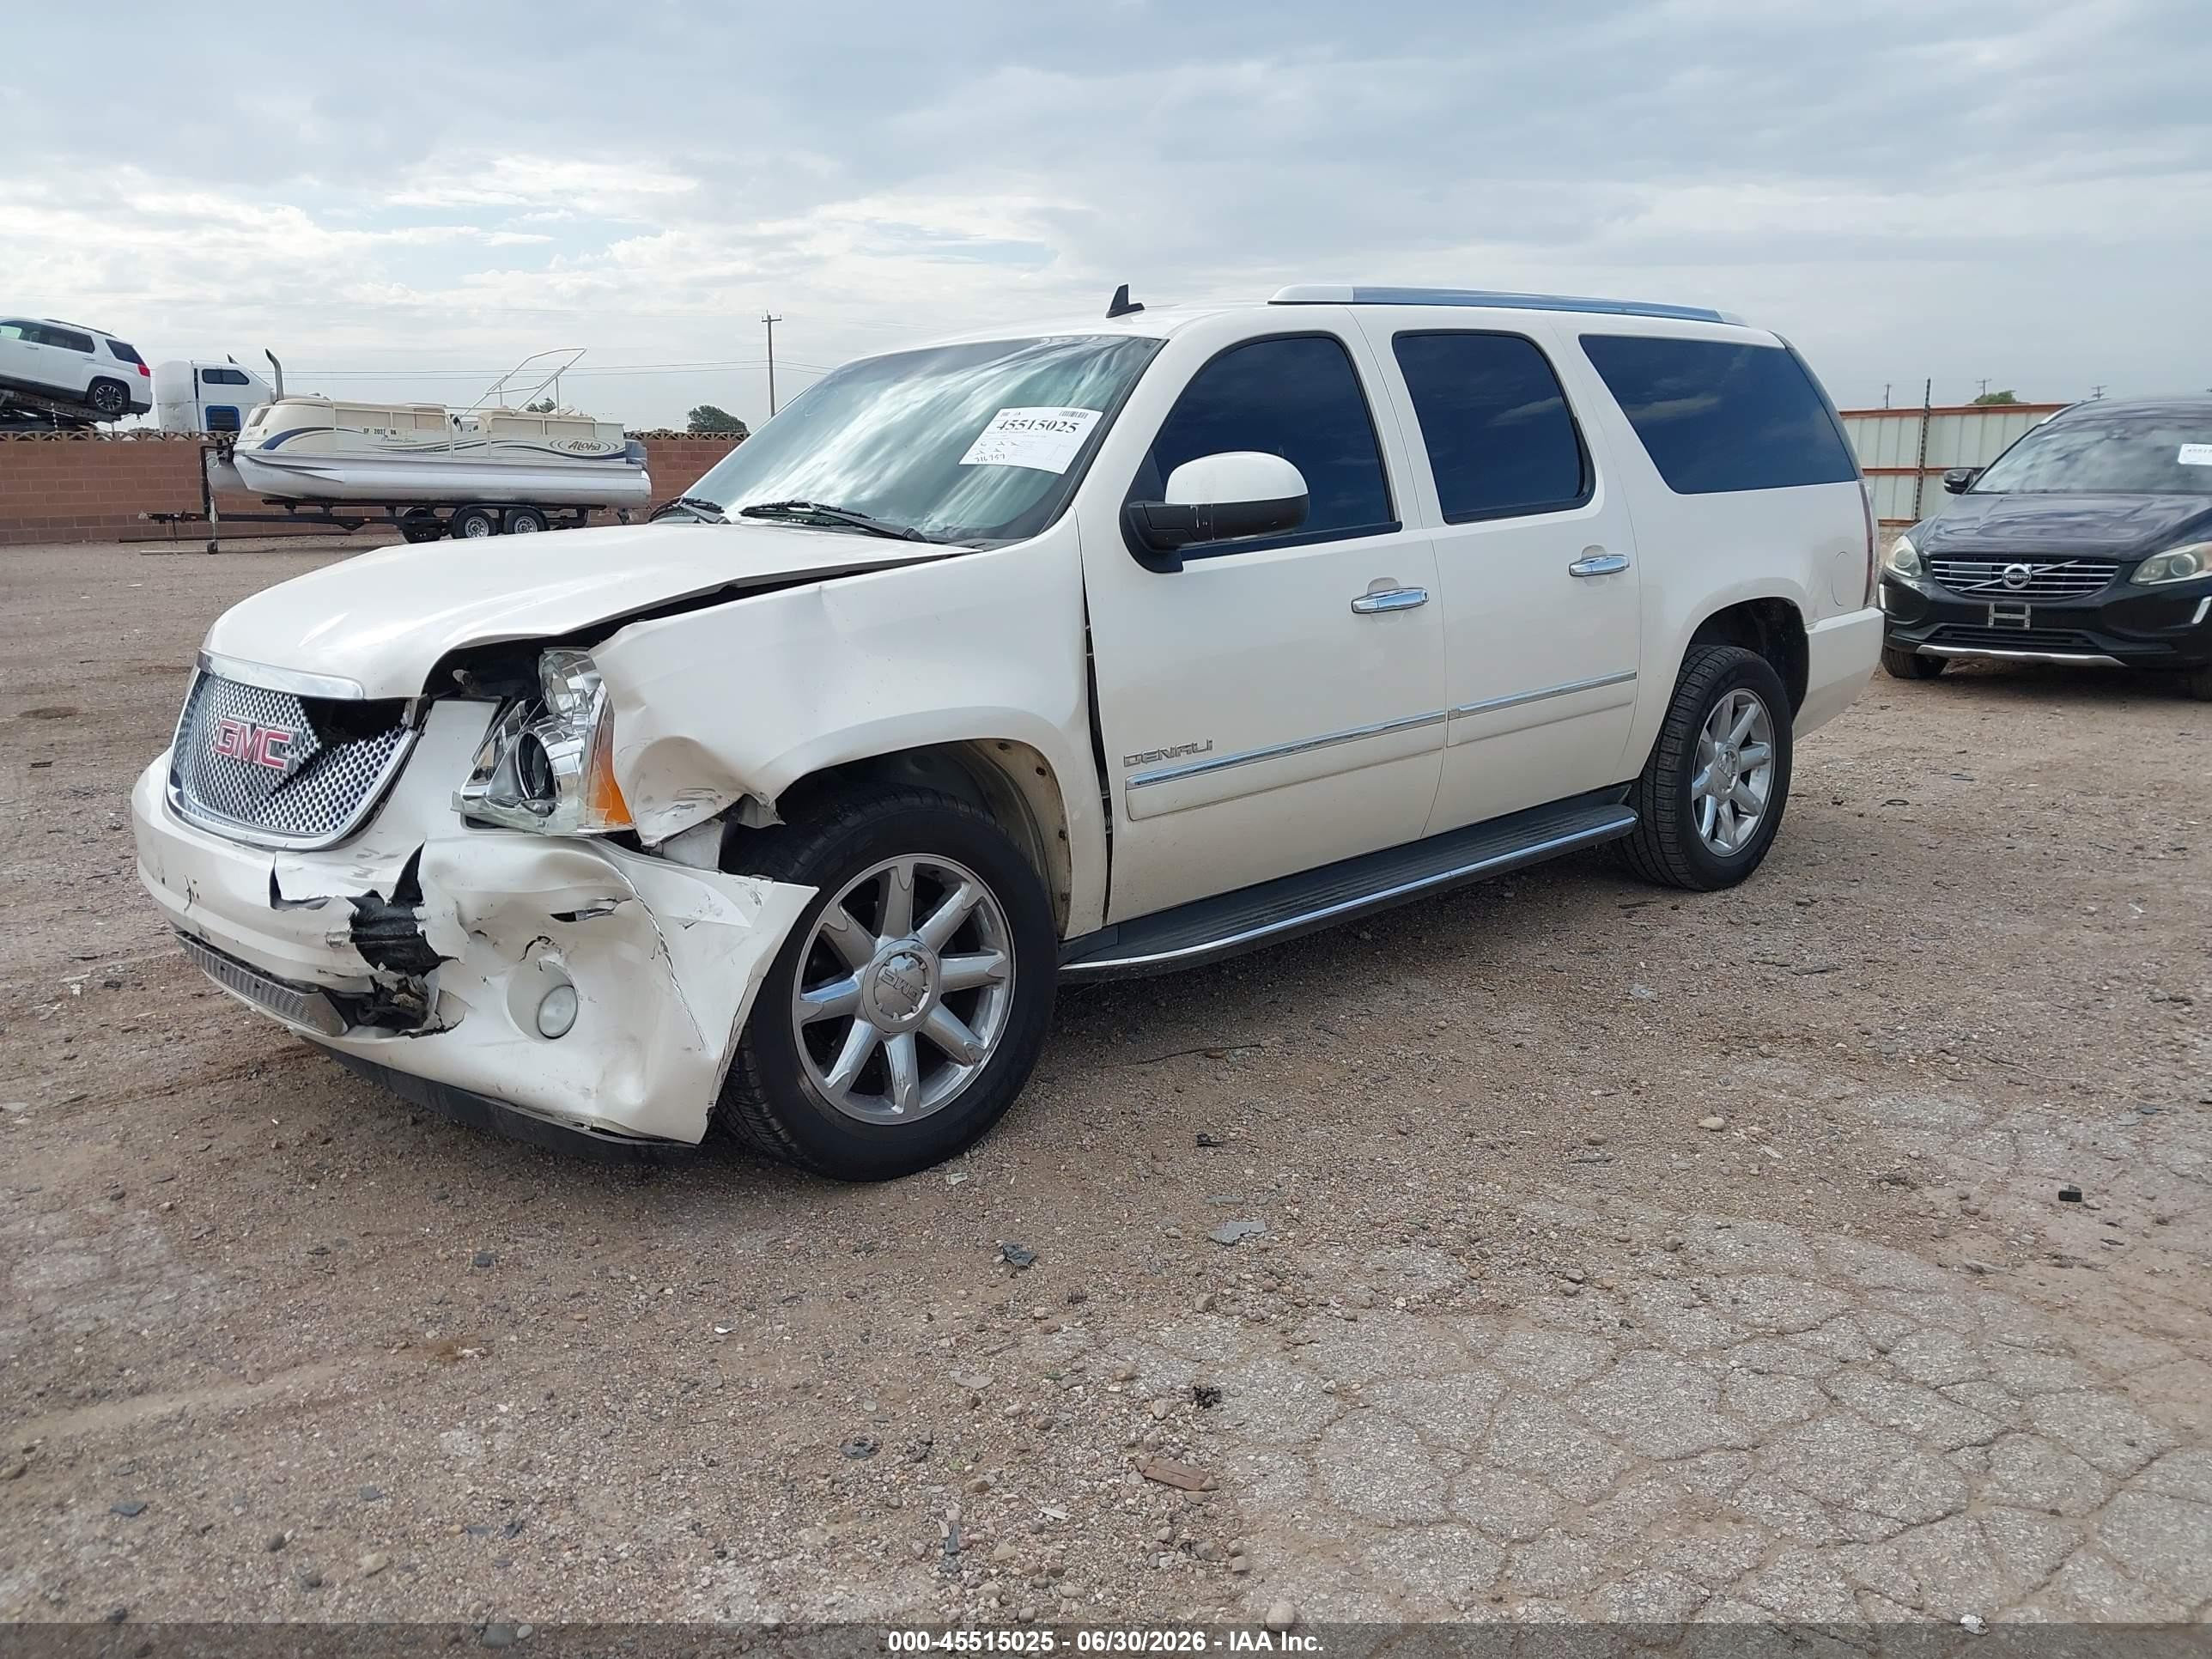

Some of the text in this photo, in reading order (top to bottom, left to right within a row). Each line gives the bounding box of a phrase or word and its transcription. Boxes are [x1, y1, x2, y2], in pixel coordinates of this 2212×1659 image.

[996, 419, 1080, 433] 45515025
[214, 718, 293, 771] GMC
[1123, 739, 1213, 768] DENALI
[880, 969, 919, 1003] GMC
